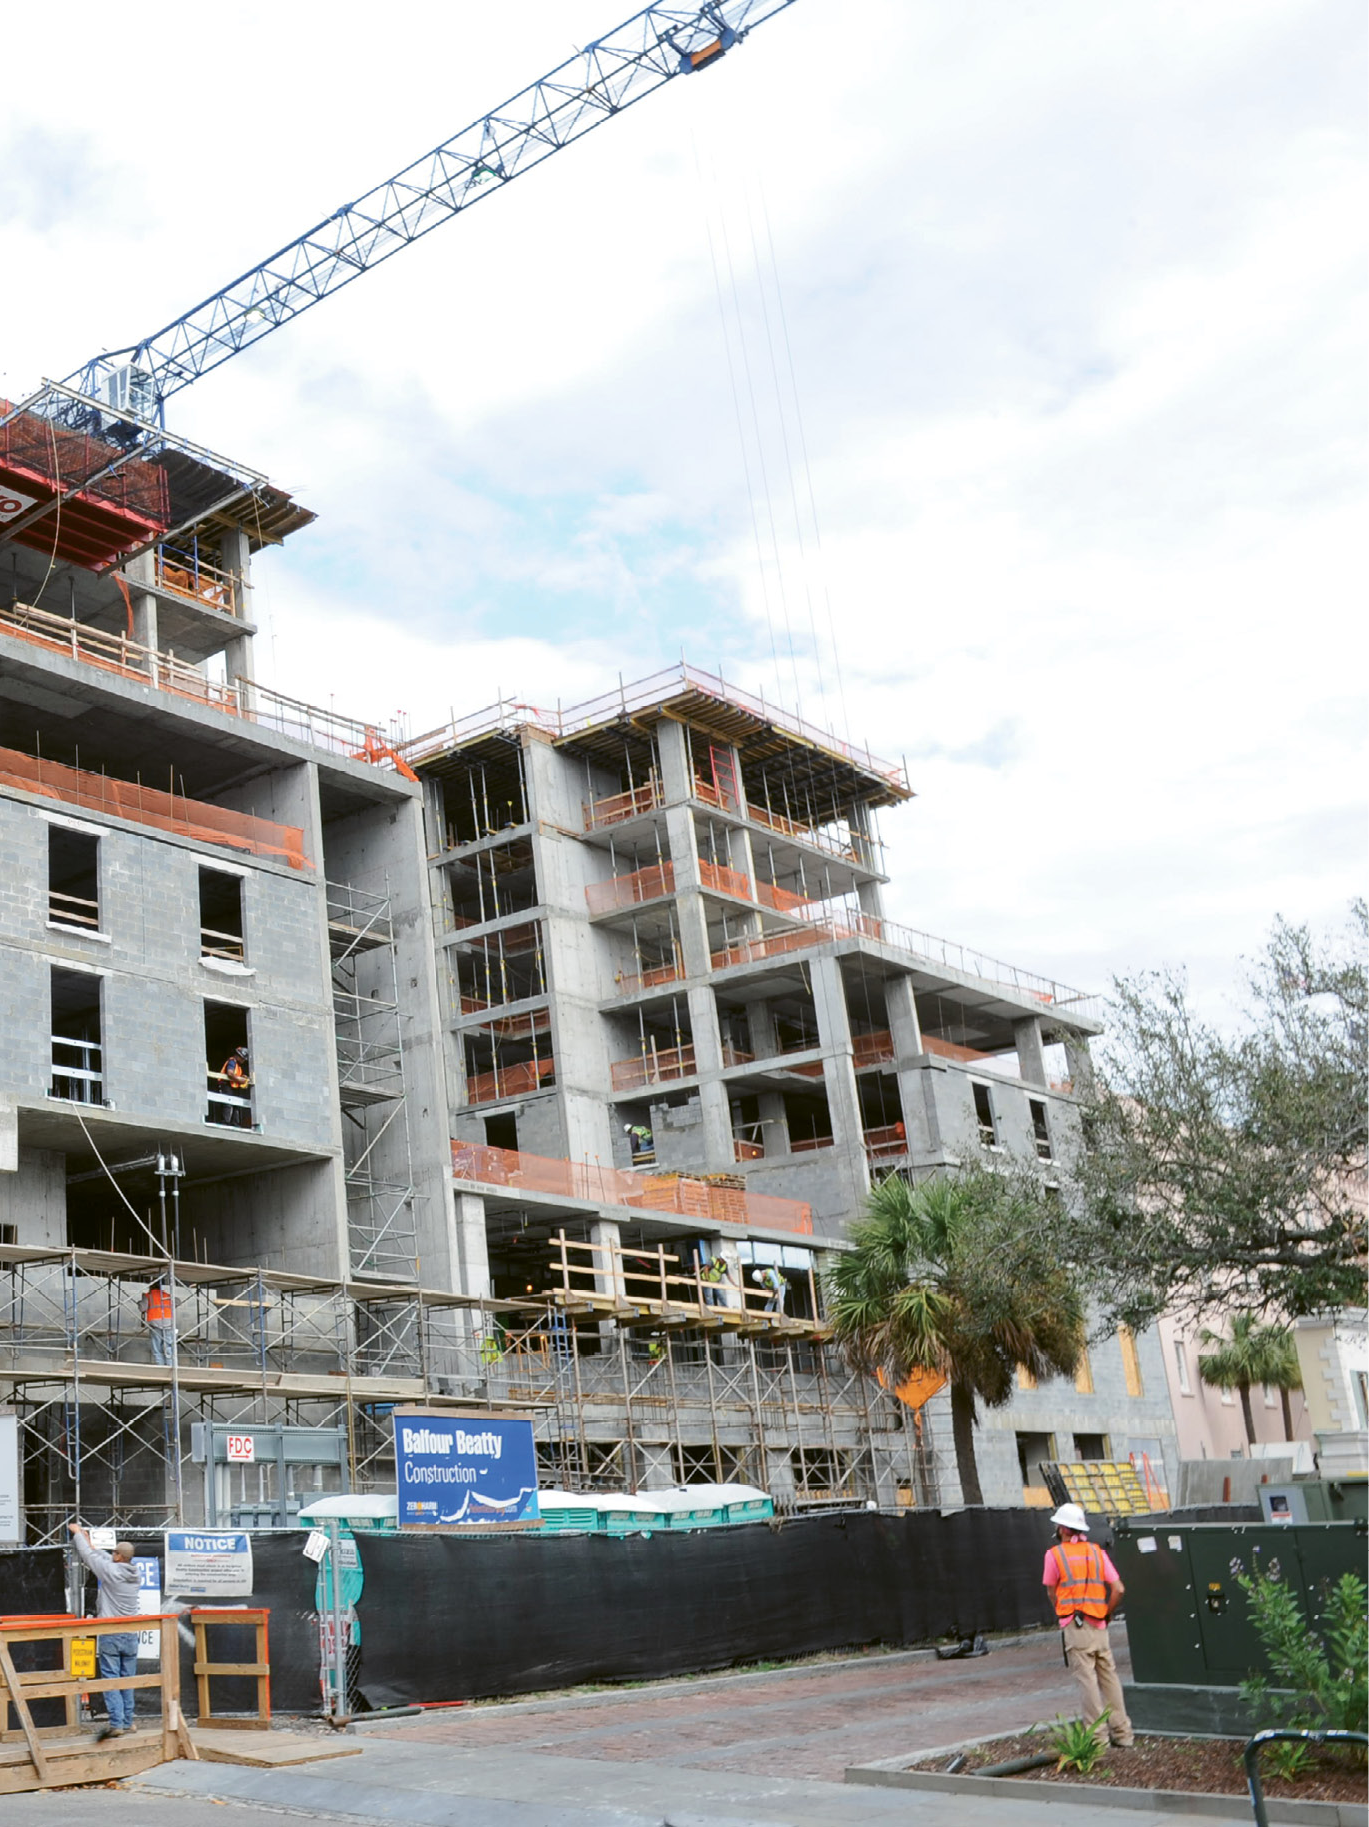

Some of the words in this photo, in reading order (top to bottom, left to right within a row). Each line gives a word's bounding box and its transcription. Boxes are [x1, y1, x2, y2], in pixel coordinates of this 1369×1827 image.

[229, 1437, 252, 1454] FDC
[402, 1427, 454, 1454] Balfour
[455, 1429, 502, 1459] Beatty
[404, 1461, 477, 1484] Construction
[184, 1536, 236, 1551] NOTICE
